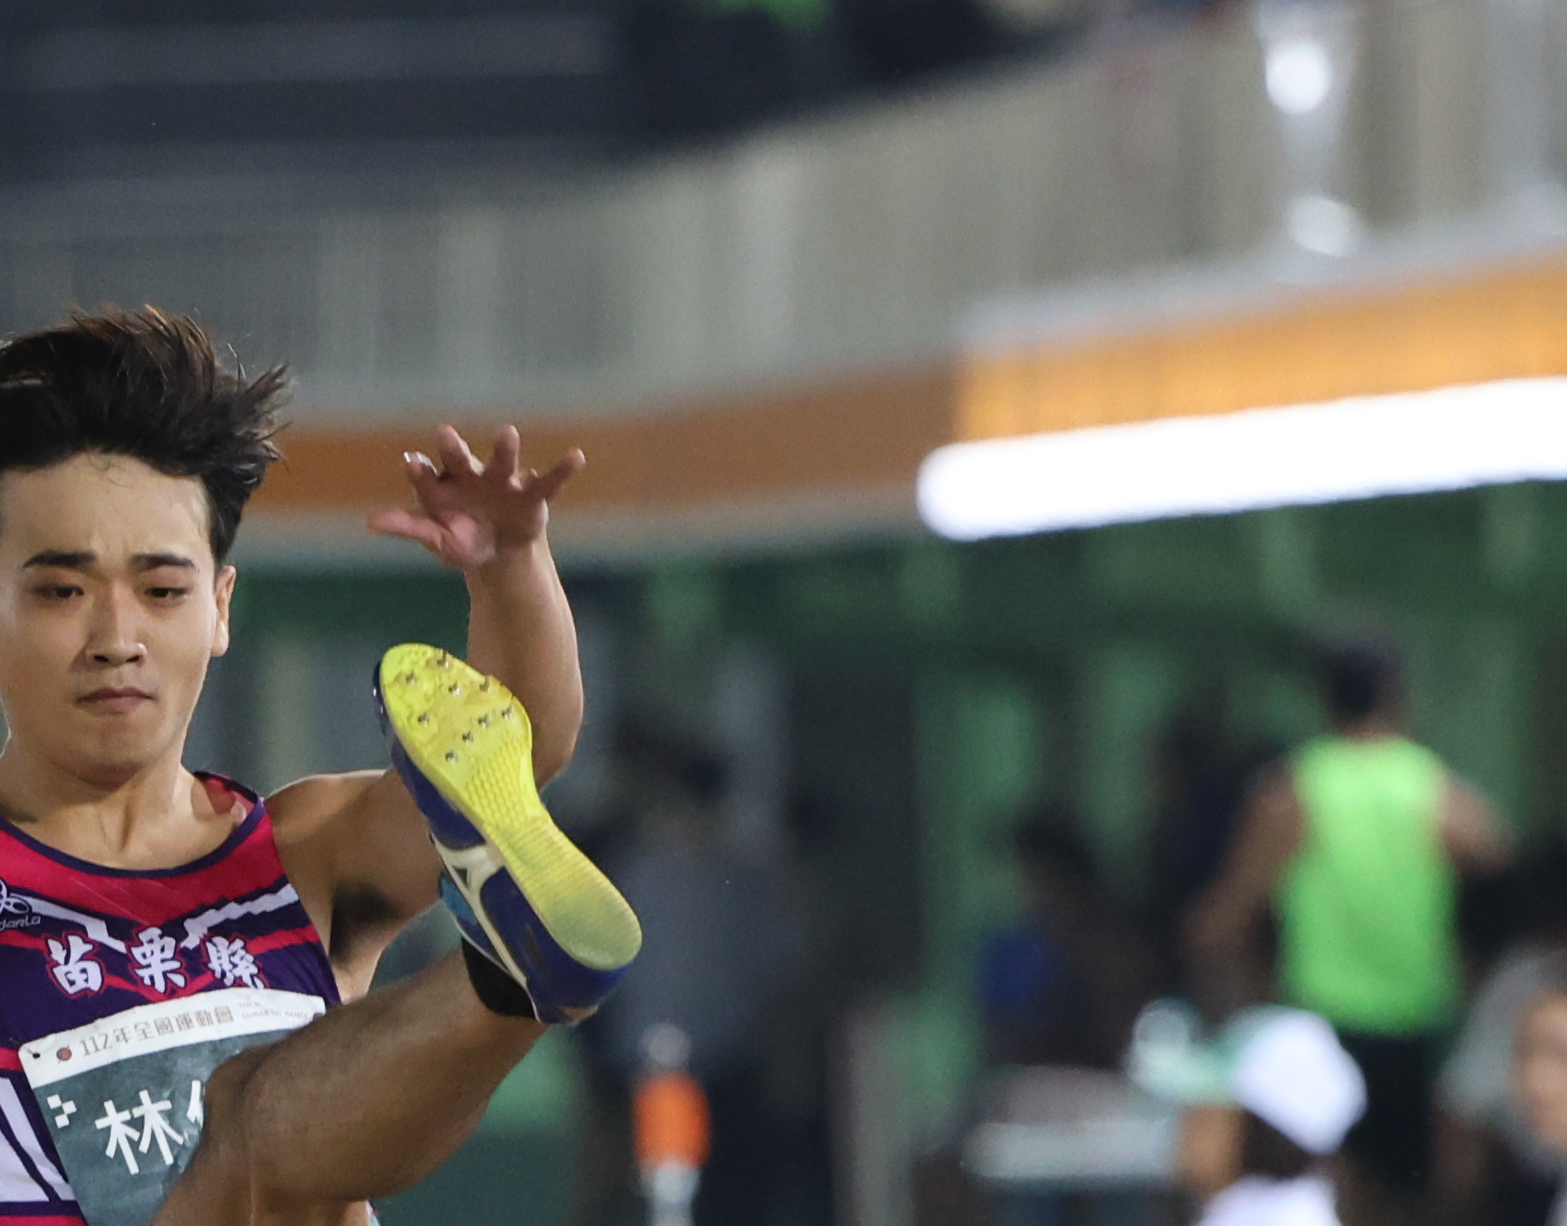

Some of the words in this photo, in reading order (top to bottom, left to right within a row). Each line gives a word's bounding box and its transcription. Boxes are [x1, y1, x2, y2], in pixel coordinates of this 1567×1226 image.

[79, 1004, 234, 1057] 112年全國運動會
[95, 1080, 205, 1175] 林
